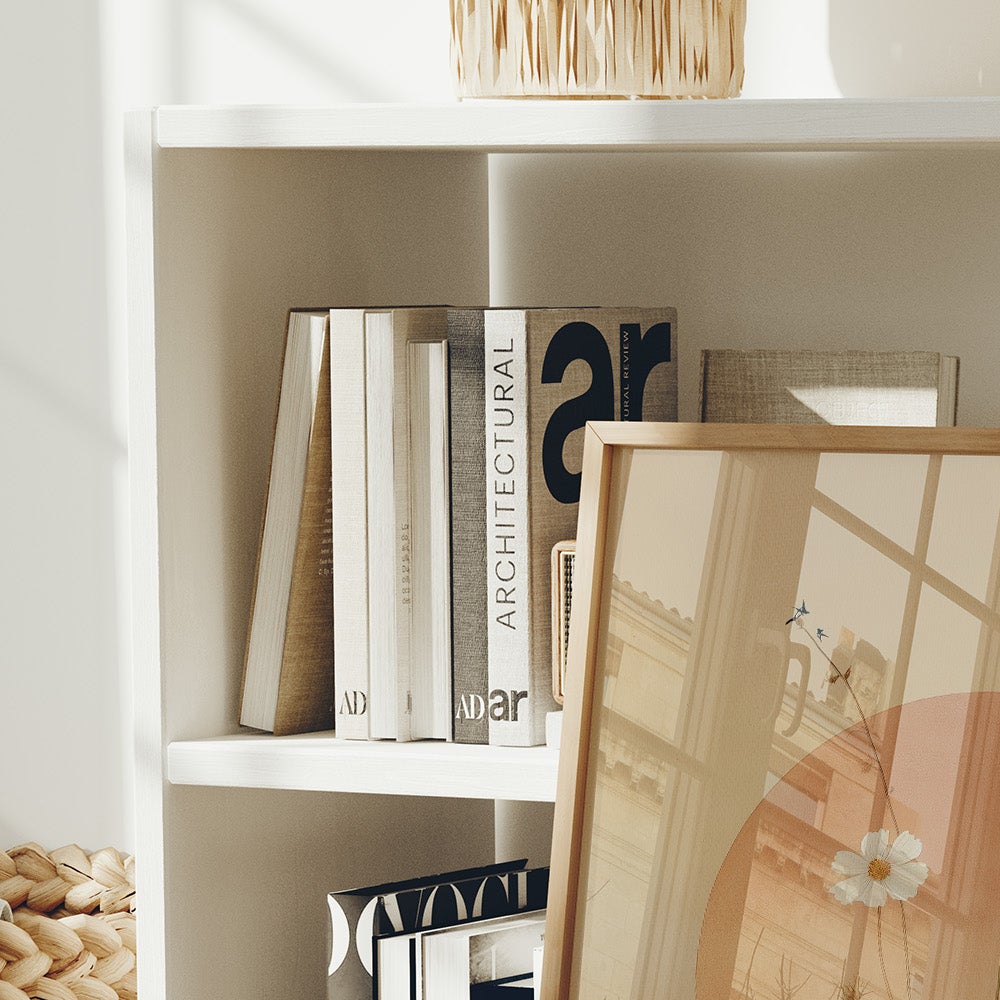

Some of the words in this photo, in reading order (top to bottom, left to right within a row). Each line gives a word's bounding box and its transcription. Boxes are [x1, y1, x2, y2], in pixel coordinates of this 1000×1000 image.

[493, 338, 516, 630] ARCHITECTURAL
[339, 690, 367, 715] AD
[455, 694, 486, 720] AD
[489, 688, 528, 722] ar
